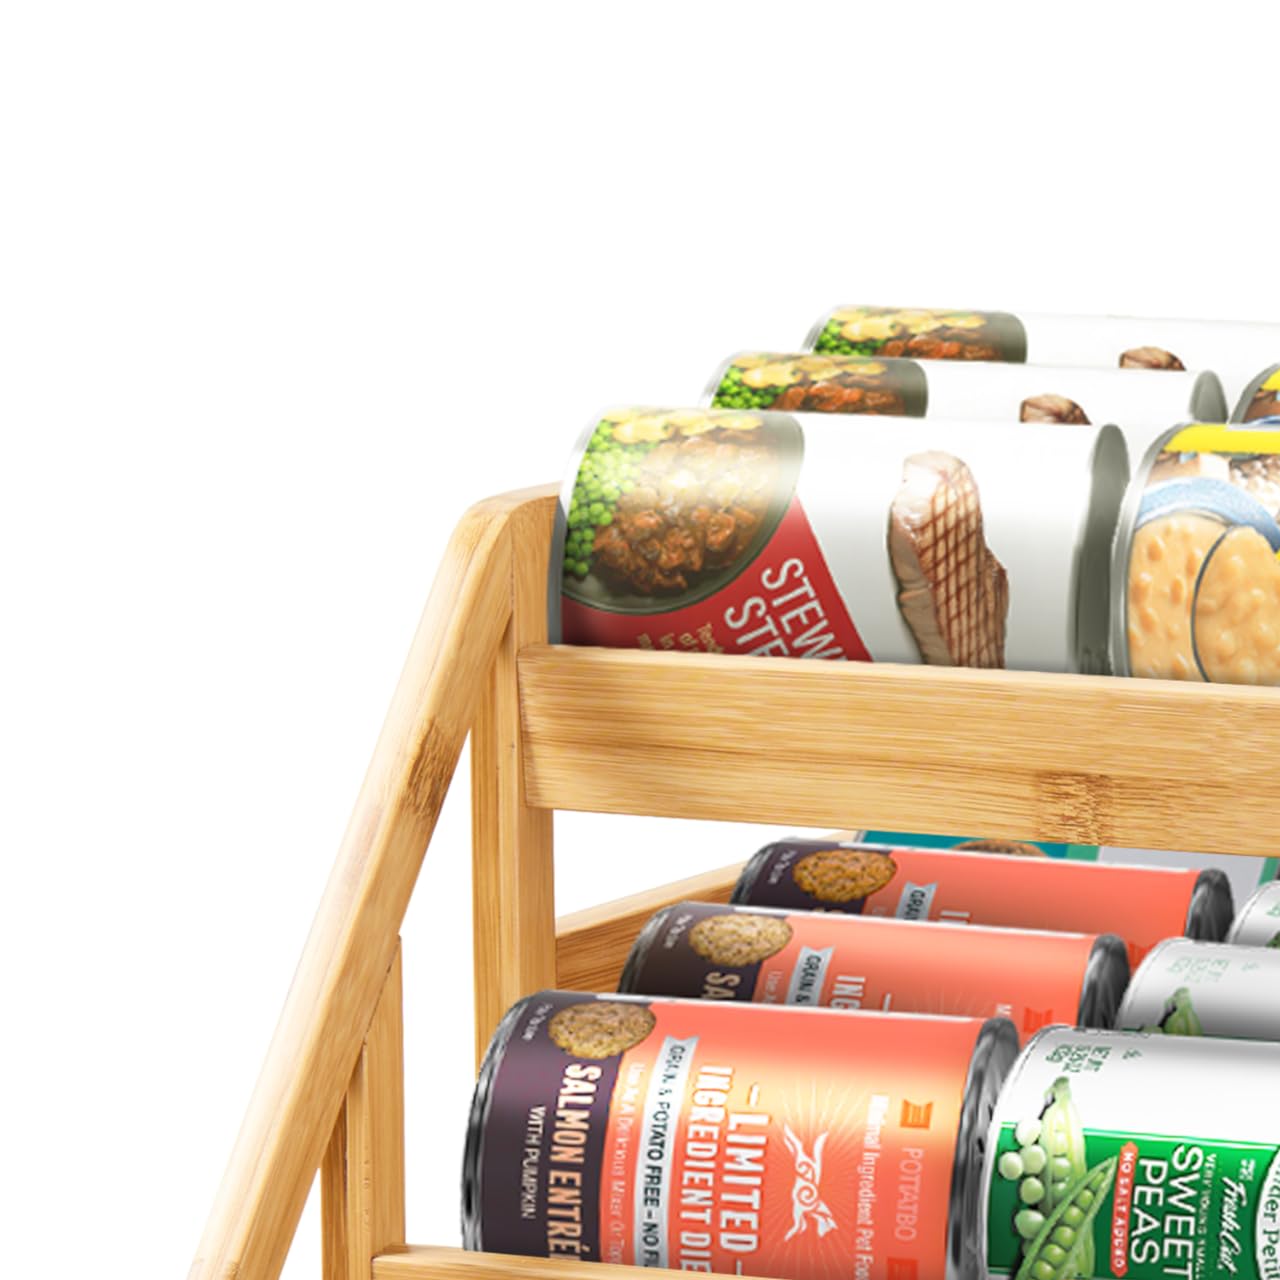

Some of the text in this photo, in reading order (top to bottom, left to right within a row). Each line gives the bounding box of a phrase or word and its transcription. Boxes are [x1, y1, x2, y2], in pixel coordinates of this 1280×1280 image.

[761, 558, 848, 661] STEW
[520, 1105, 547, 1221] WITH PUMPKIN
[546, 1062, 603, 1262] SALMON ENTRÉ
[647, 1100, 671, 1161] POTATO
[679, 1064, 735, 1274] INGREDIENT DIE
[641, 1220, 661, 1248] NO
[642, 1165, 664, 1209] FREE
[718, 1112, 771, 1254] LIMITED
[856, 1150, 881, 1226] Ingredient
[1112, 1150, 1135, 1268] NO SALT ADDED
[1130, 1156, 1169, 1265] PEAS
[643, 1249, 661, 1268] FI
[854, 1227, 875, 1251] Pet
